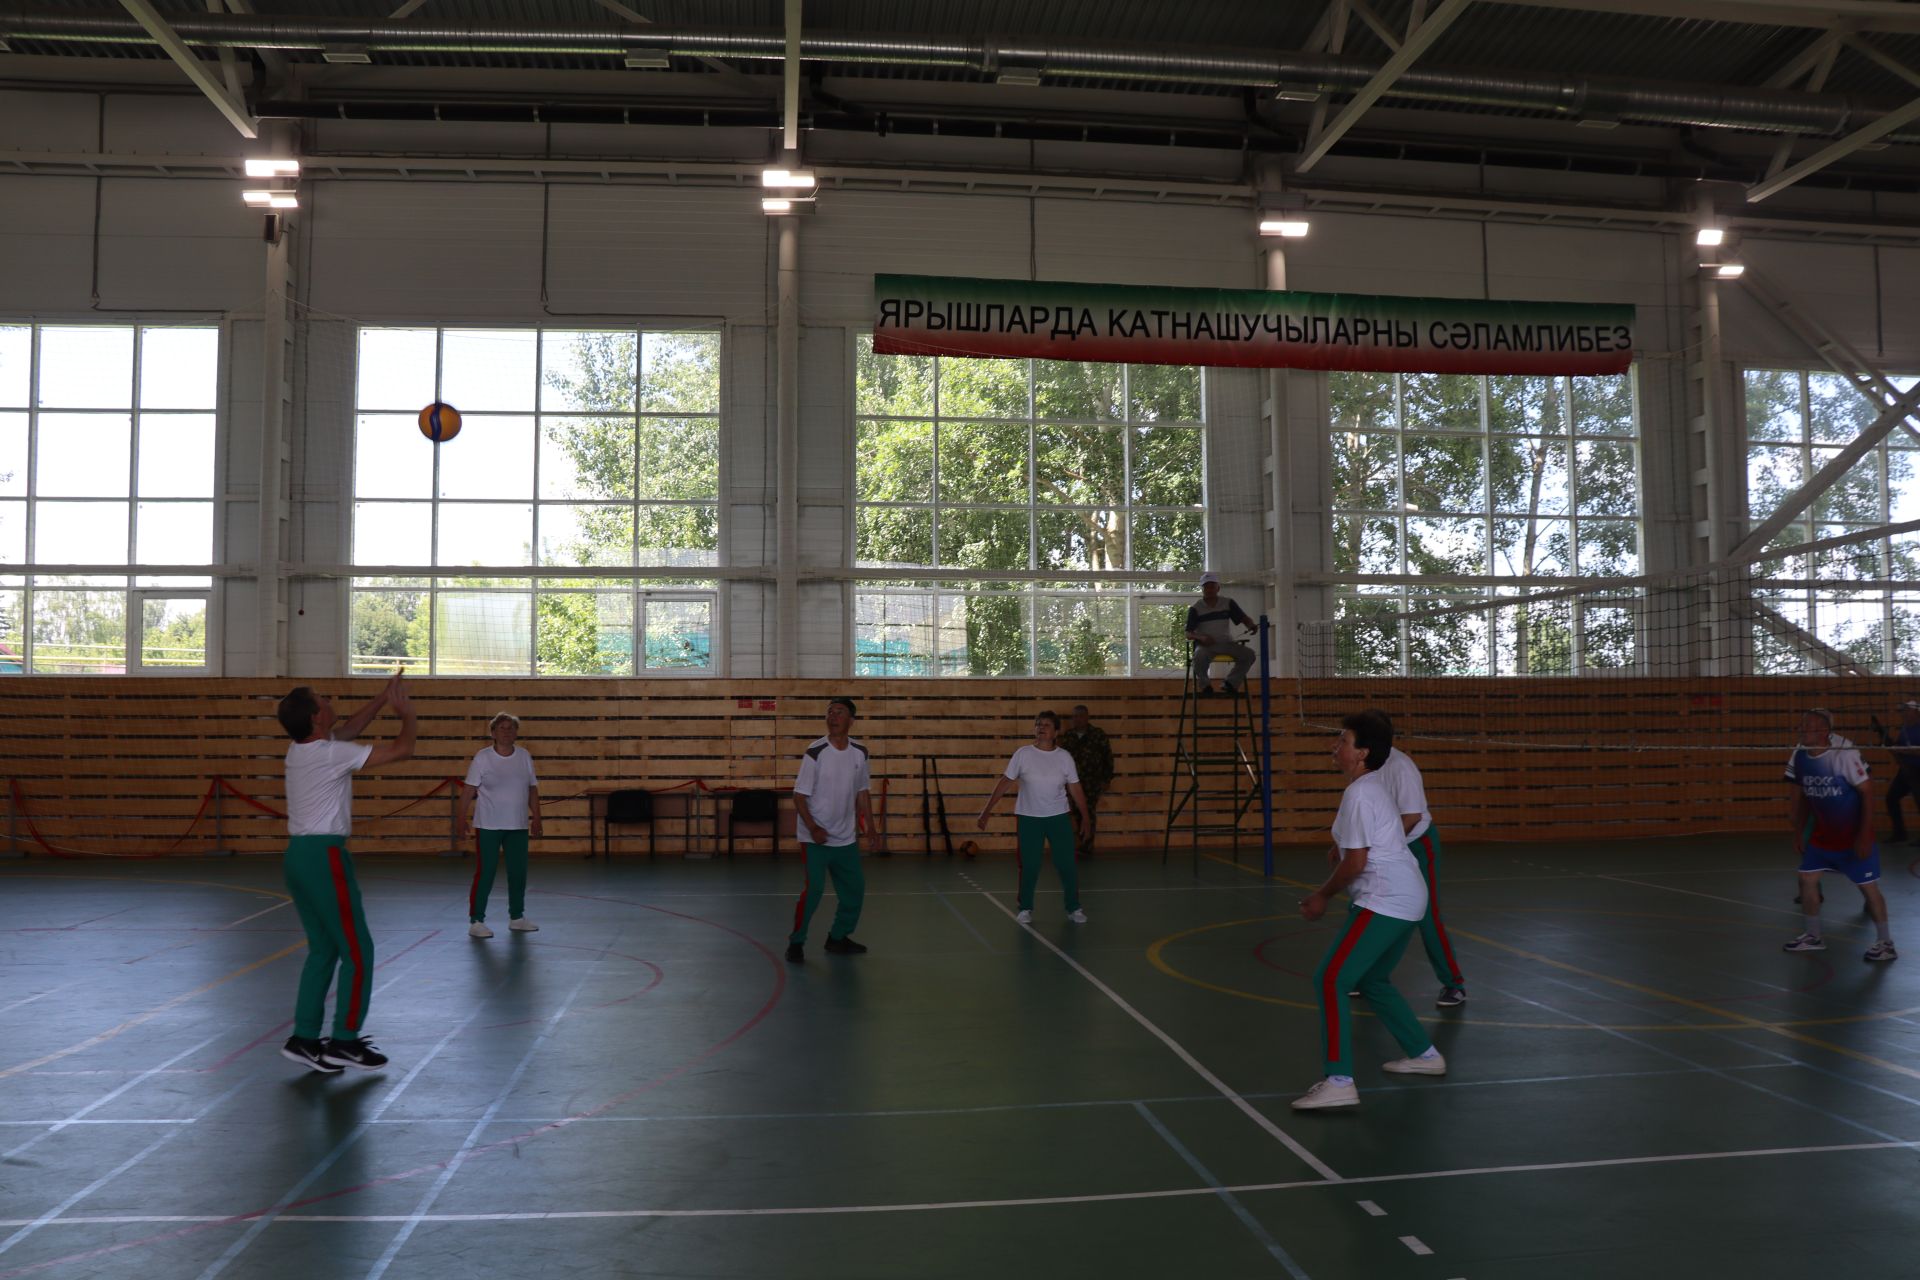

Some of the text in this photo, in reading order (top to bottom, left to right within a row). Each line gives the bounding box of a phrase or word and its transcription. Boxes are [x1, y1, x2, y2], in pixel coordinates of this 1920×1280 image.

[879, 299, 1632, 353] ЯРЫШЛАРДА КАТНАШУЧЫЛАРНЫ СӘЛАМЛИБЕЗ
